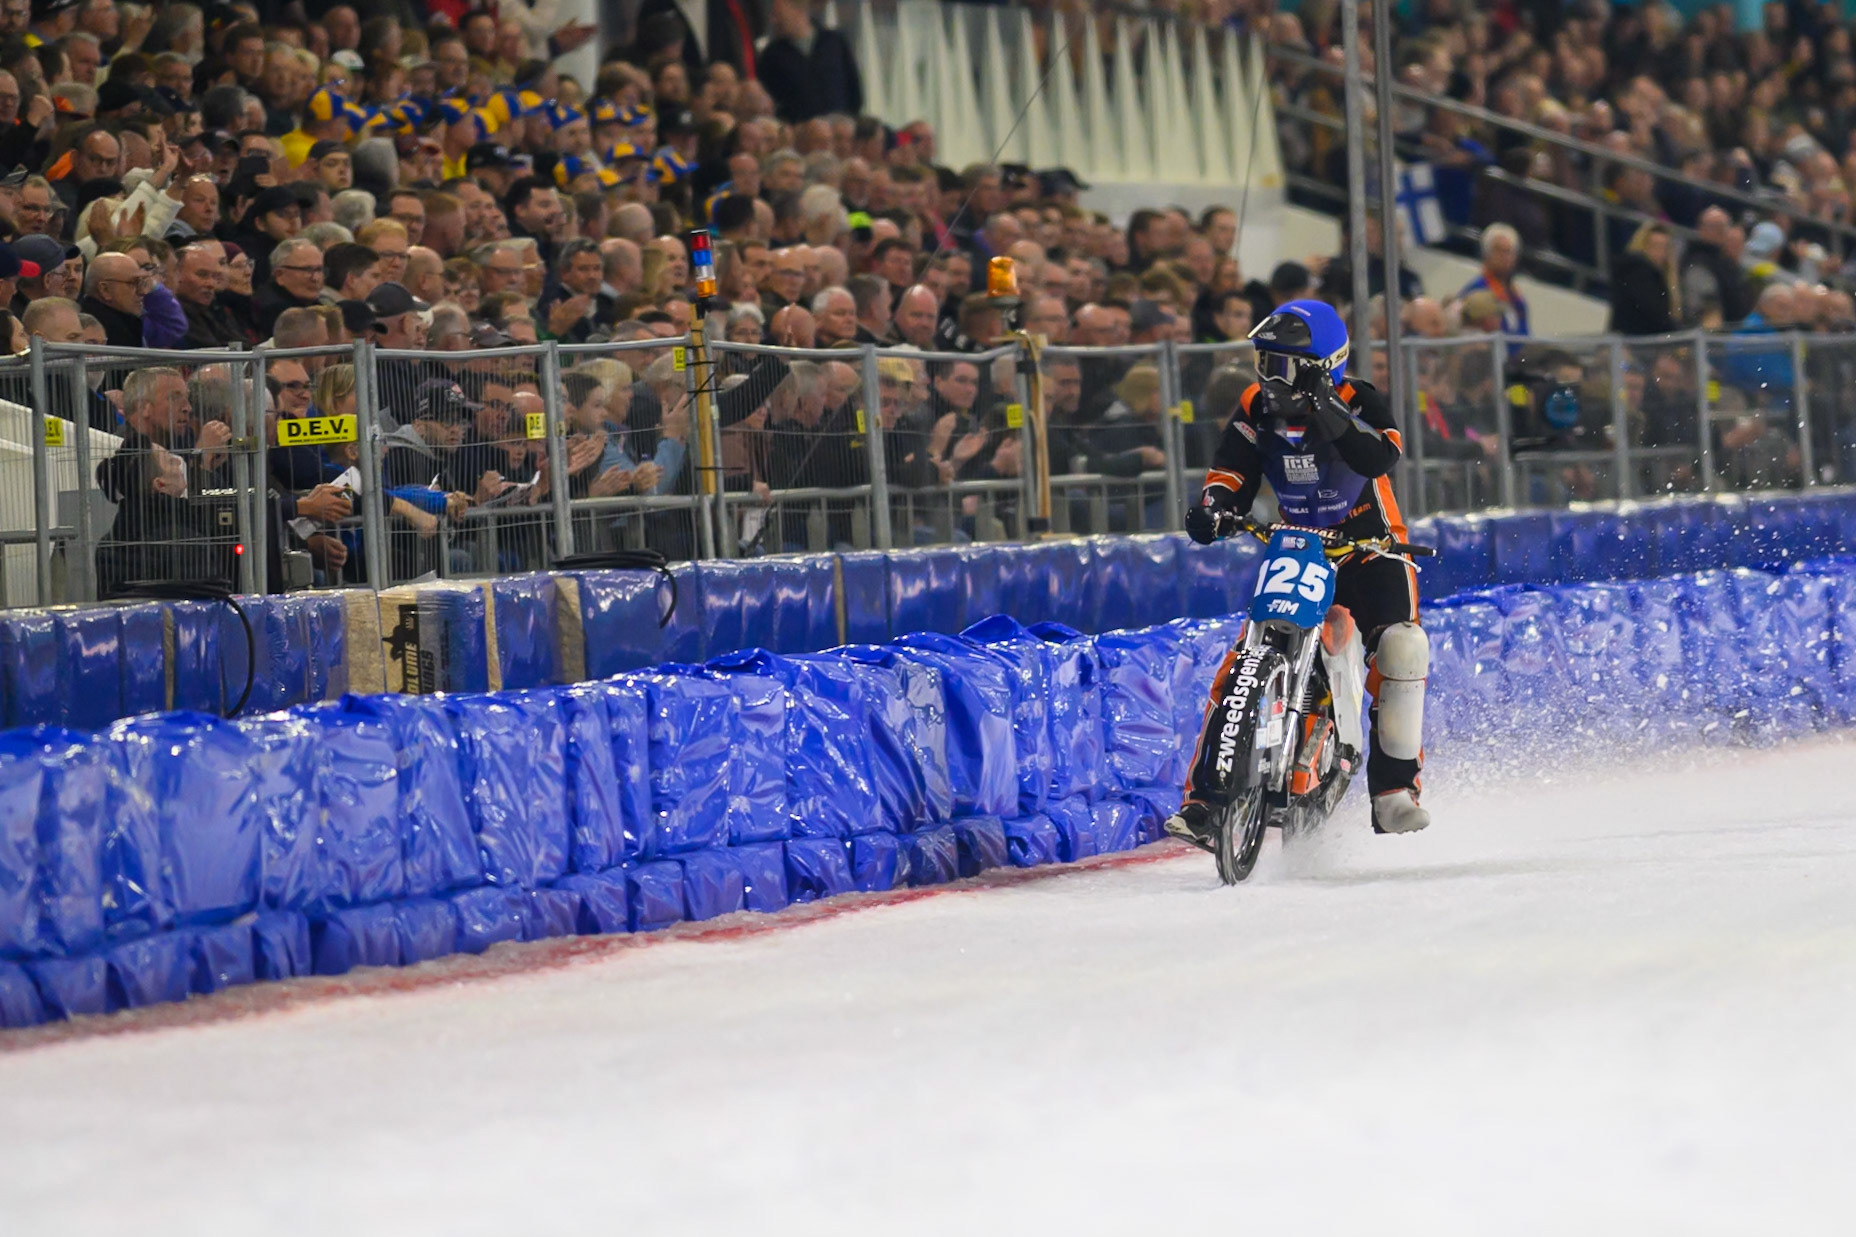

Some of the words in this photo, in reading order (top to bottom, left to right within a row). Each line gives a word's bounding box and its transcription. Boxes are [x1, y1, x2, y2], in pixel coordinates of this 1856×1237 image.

[287, 418, 349, 438] D.E.V.
[1283, 454, 1316, 468] ICE
[1254, 557, 1329, 602] 125
[1267, 599, 1300, 615] FIM
